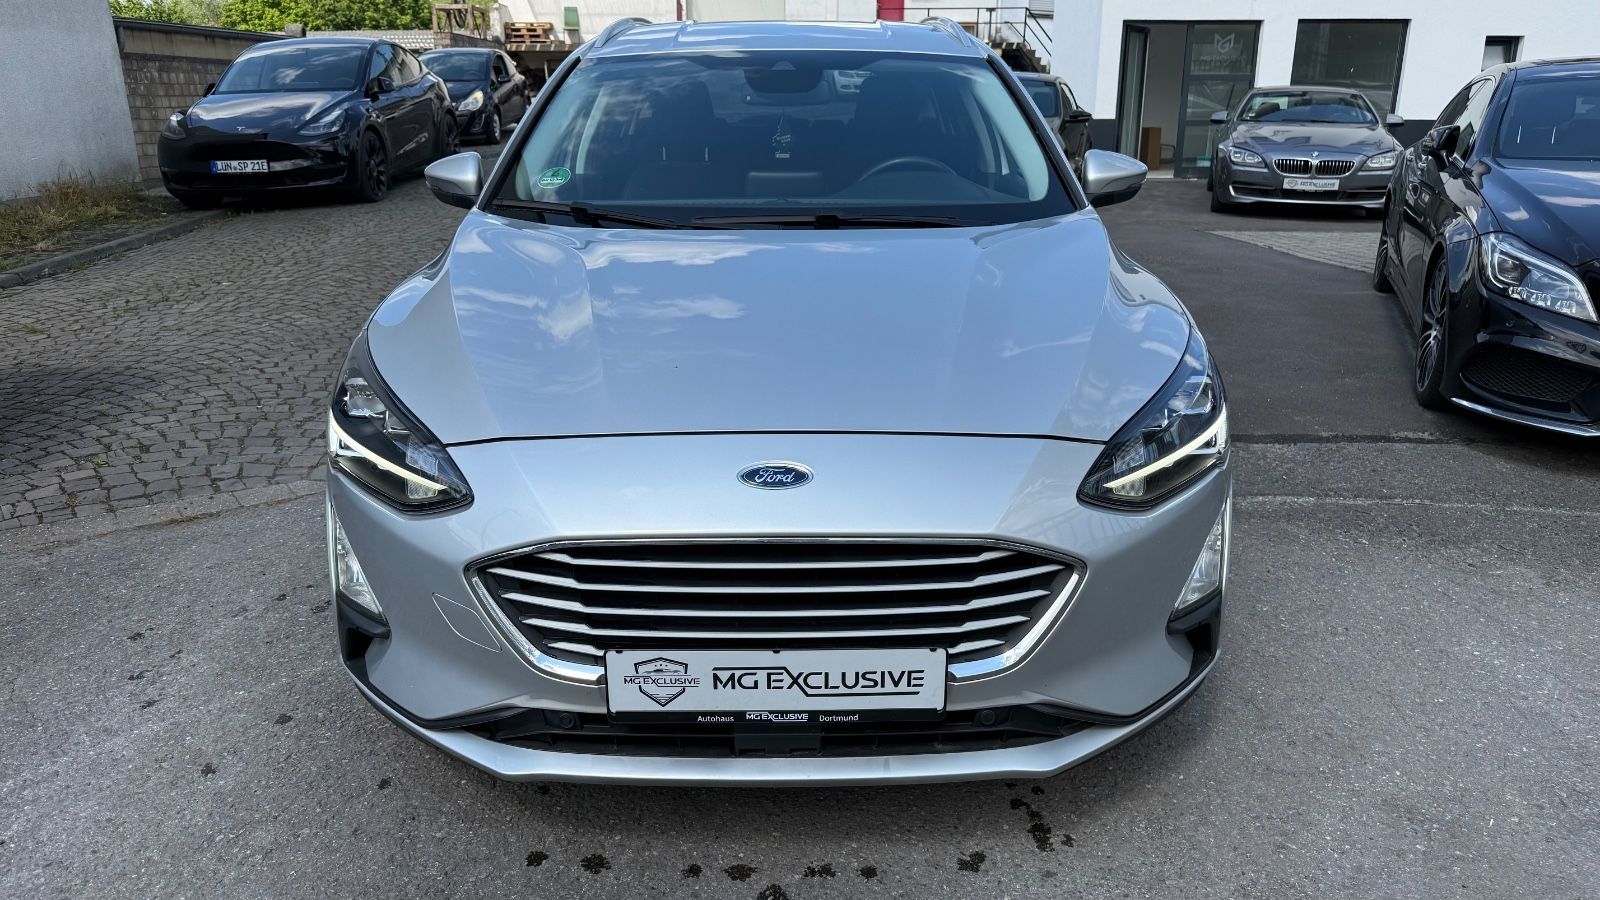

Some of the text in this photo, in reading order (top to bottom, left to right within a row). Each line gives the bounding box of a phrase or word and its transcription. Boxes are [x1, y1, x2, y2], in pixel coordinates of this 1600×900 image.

[217, 161, 267, 171] LÜN SP 21E
[755, 469, 796, 483] Ford
[624, 676, 700, 687] MG EXCLUSIVE
[712, 668, 925, 694] MG EXCLUSIVE
[697, 715, 734, 723] Autohaus
[761, 712, 809, 721] EXCLUSIVE
[819, 714, 859, 723] Dortmund
